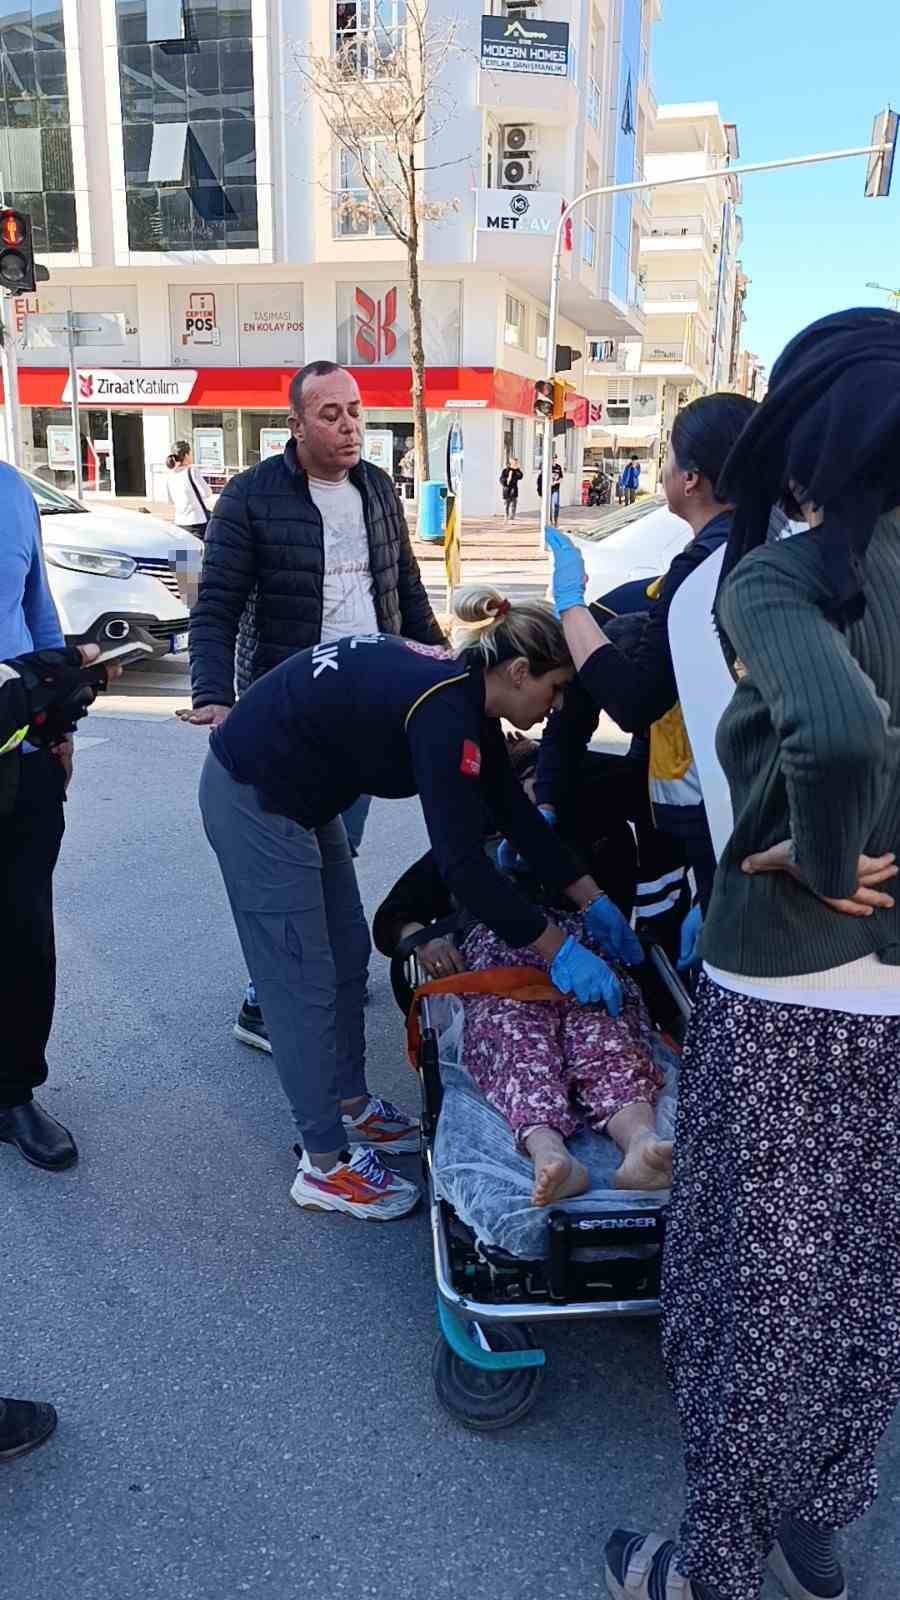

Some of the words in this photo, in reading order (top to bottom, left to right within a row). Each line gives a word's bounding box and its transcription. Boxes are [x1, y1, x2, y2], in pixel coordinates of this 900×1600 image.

[483, 44, 527, 59] MODERN
[529, 48, 566, 62] HOMES
[186, 319, 213, 331] POS
[243, 322, 256, 332] EN
[257, 322, 286, 332] KOLAY
[287, 322, 304, 332] POS
[97, 379, 136, 394] Ziraat
[136, 379, 179, 394] Katılım
[577, 1217, 657, 1230] SPENCER
